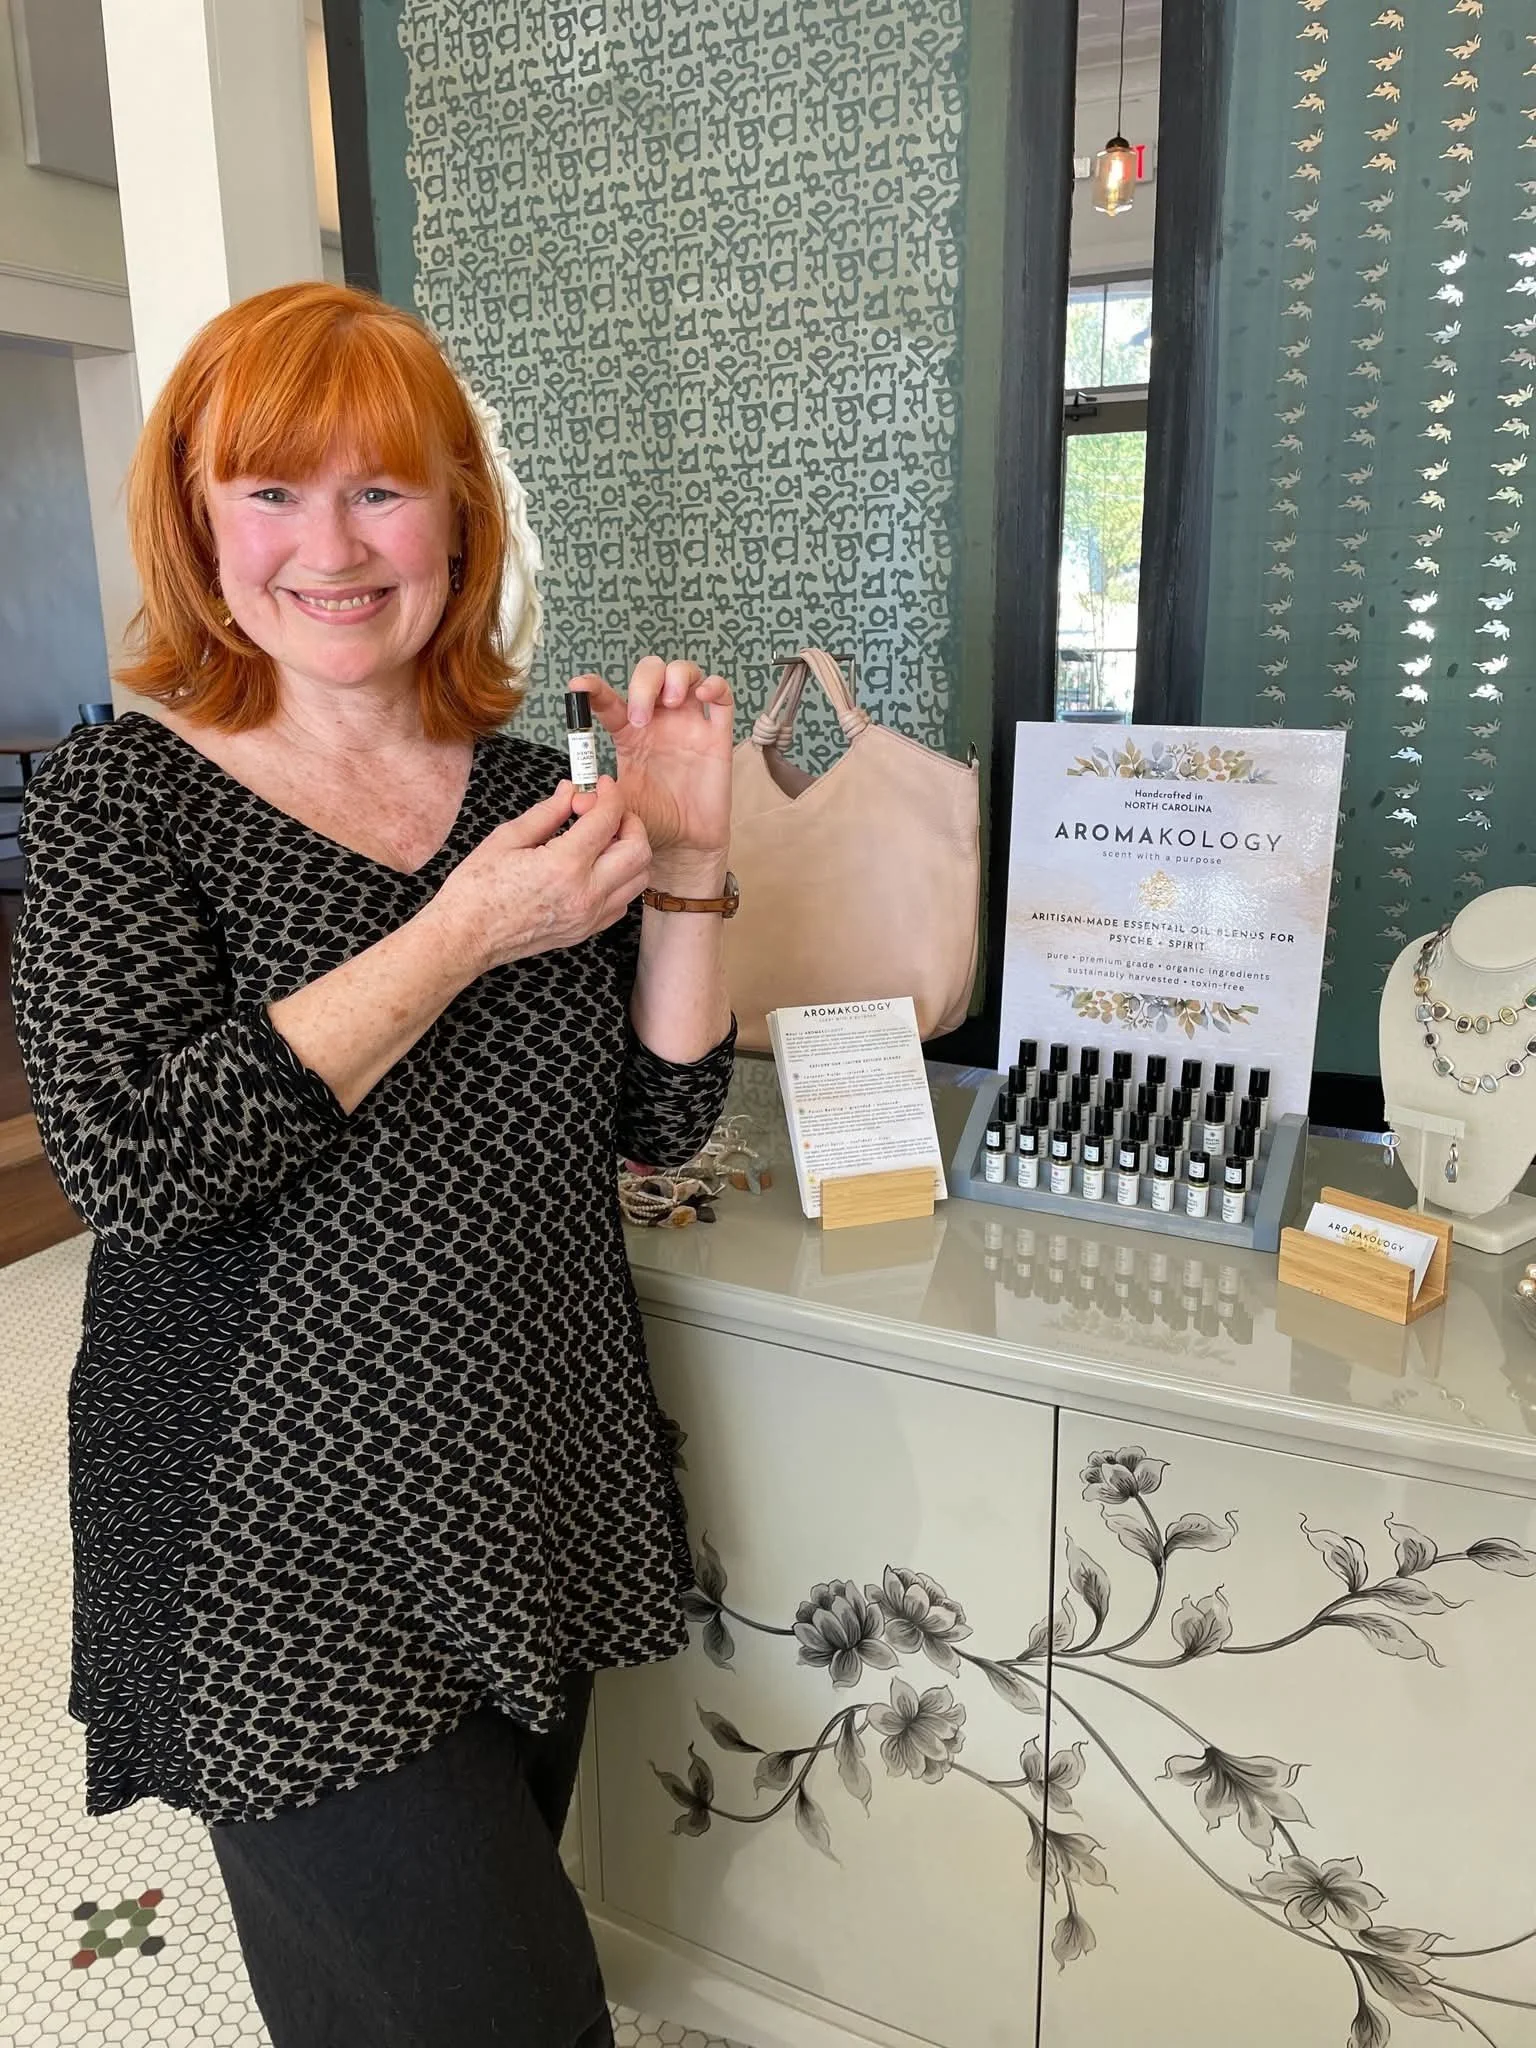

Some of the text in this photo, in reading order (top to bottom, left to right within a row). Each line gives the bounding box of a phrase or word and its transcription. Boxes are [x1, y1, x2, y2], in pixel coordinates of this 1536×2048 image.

[1135, 789, 1192, 800] Handcrafted
[1124, 801, 1212, 813] NORTH CAROLINA
[1055, 821, 1282, 852] AROMAKOLOGY
[1102, 849, 1132, 859] scent
[1137, 851, 1160, 861] with
[1175, 855, 1222, 865] purpose
[1109, 933, 1205, 951] PSYCHE SPIRIT
[1191, 926, 1211, 935] OIL
[1270, 933, 1295, 943] FOR
[1046, 952, 1270, 981] pure premium grade organic ingredients
[1067, 967, 1245, 991] sustainably harvested toxin-free
[803, 1001, 892, 1018] AROMAKOLOGY
[1328, 1222, 1404, 1252] AROMAKOLOGY
